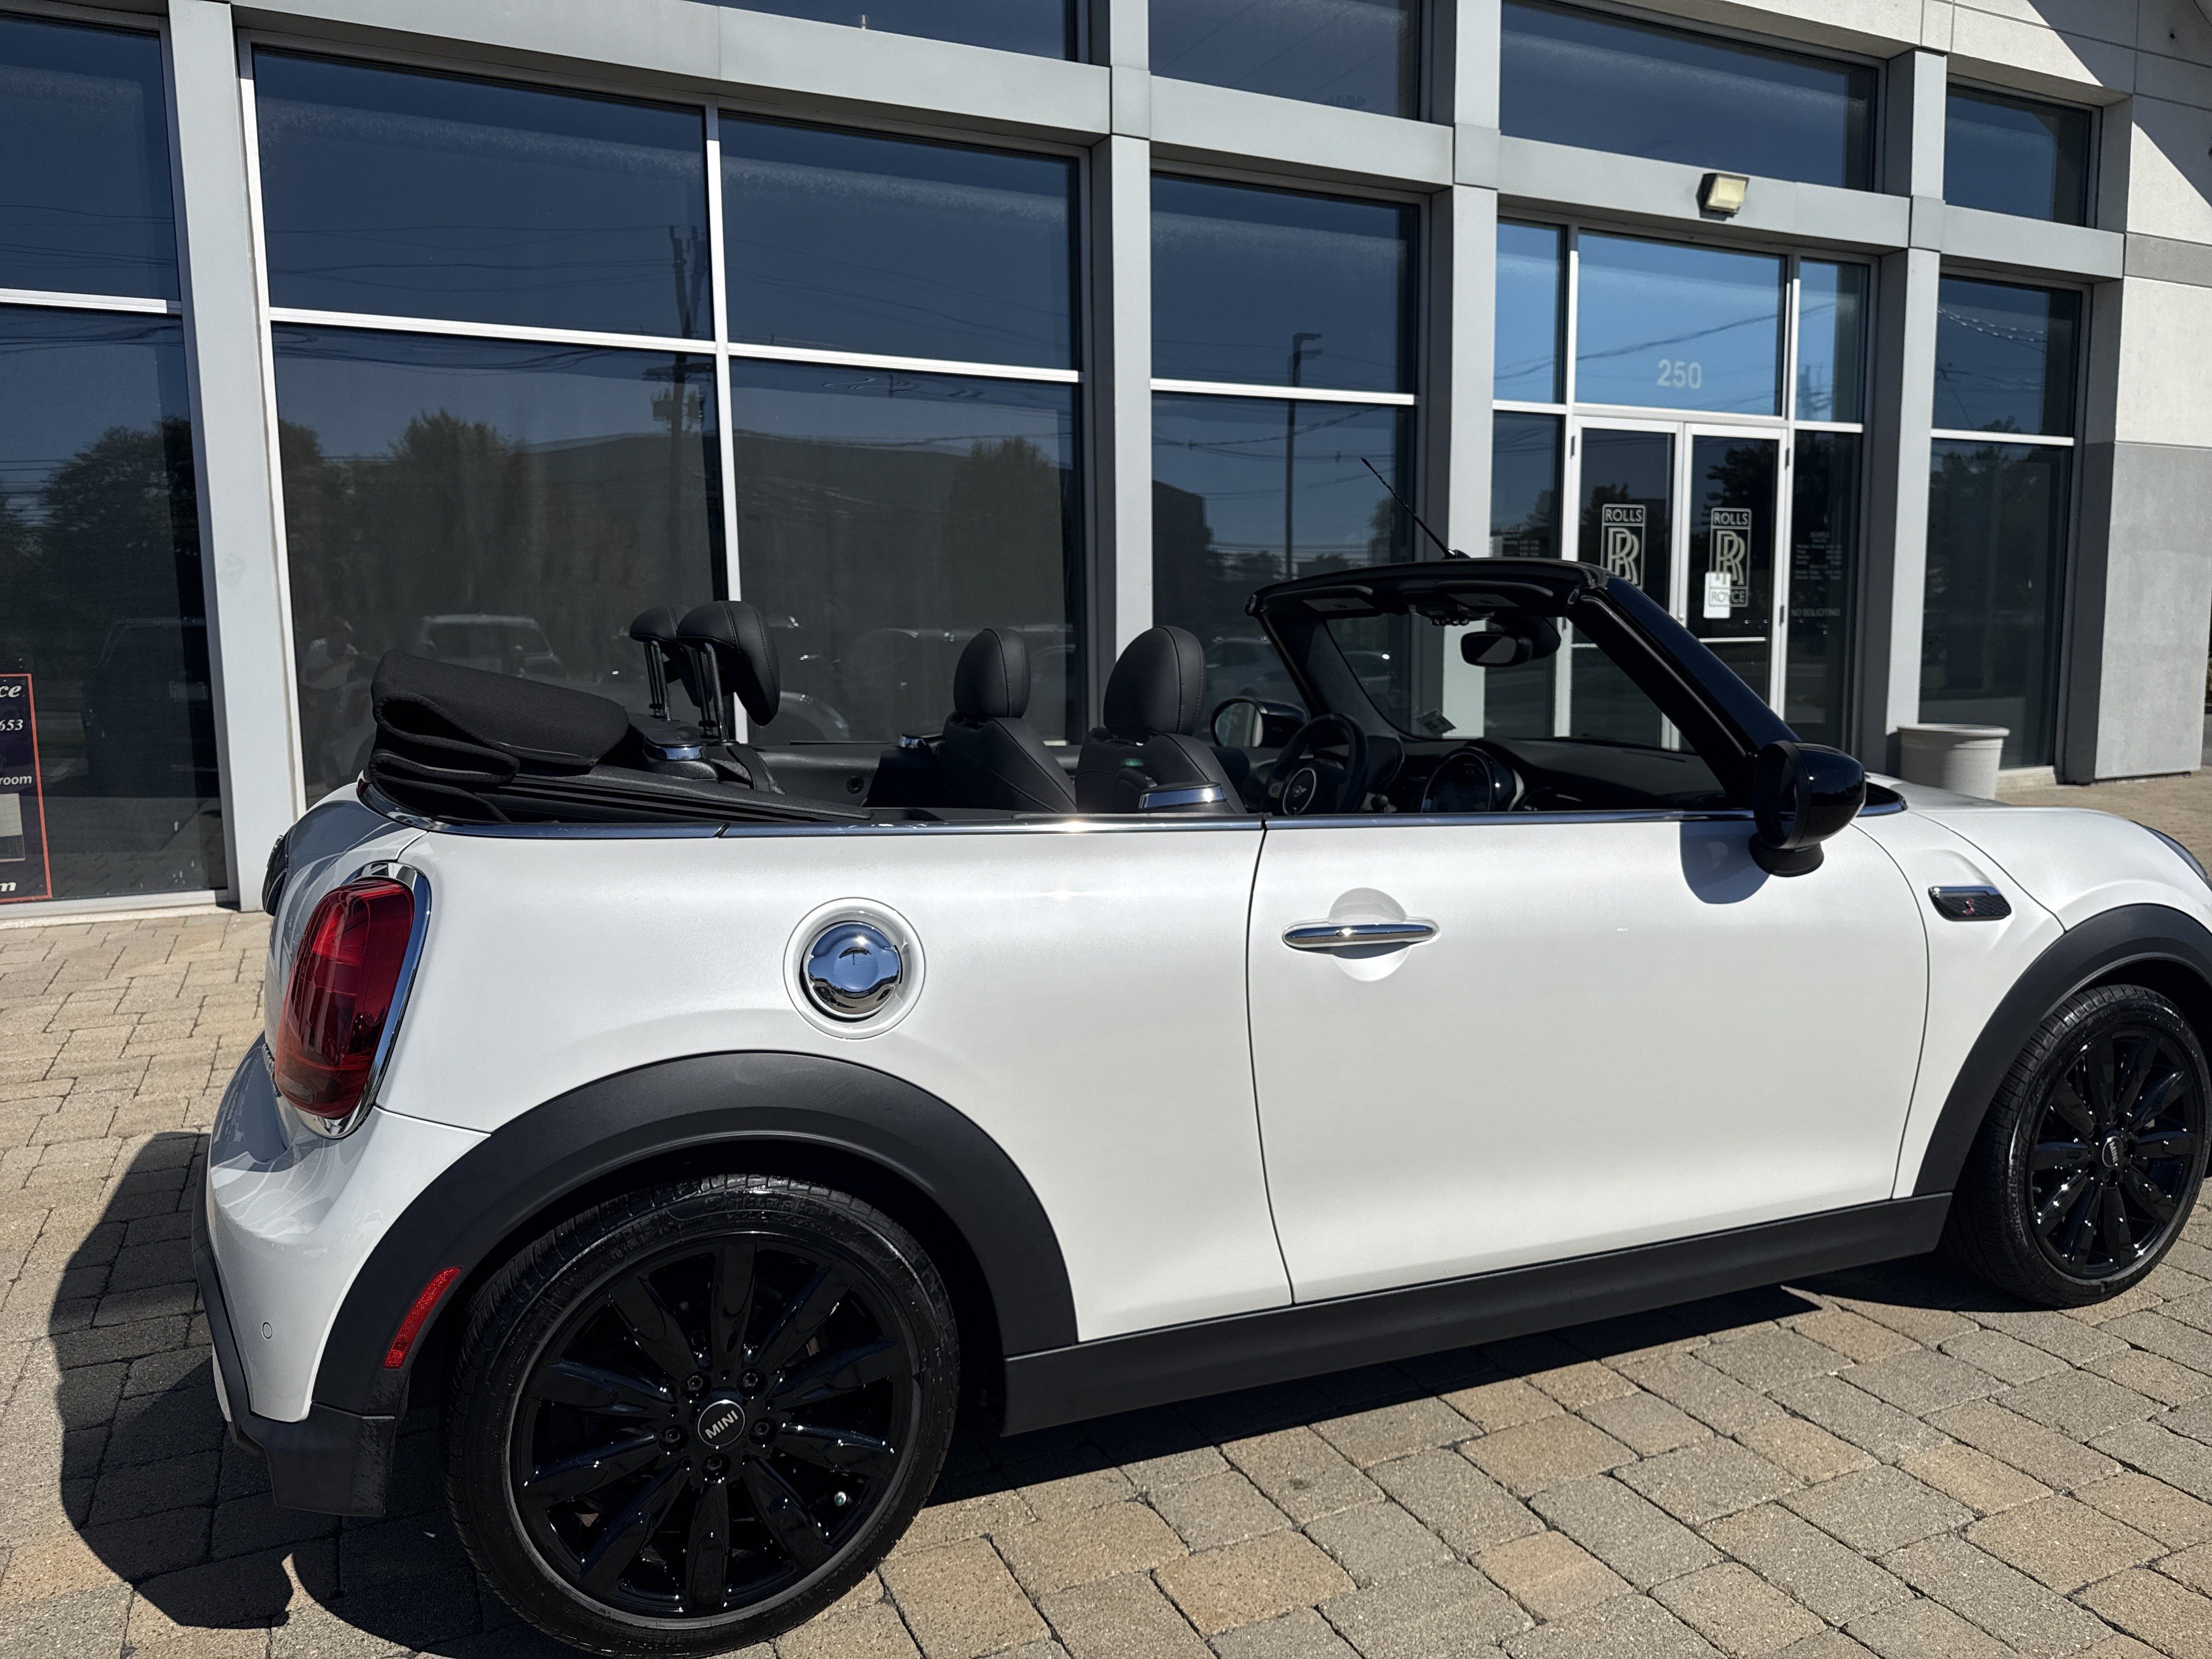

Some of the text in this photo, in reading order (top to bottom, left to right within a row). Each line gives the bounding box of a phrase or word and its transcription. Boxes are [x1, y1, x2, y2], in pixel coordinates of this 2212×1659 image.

[1657, 359, 1702, 390] 250
[1605, 509, 1643, 522] ROLLS
[1713, 512, 1748, 525] ROLLS
[1711, 589, 1746, 603] ROYCE
[1791, 607, 1801, 617] NO
[1962, 898, 1976, 916] S
[2109, 1141, 2119, 1164] MINI
[704, 1409, 739, 1439] MINI
